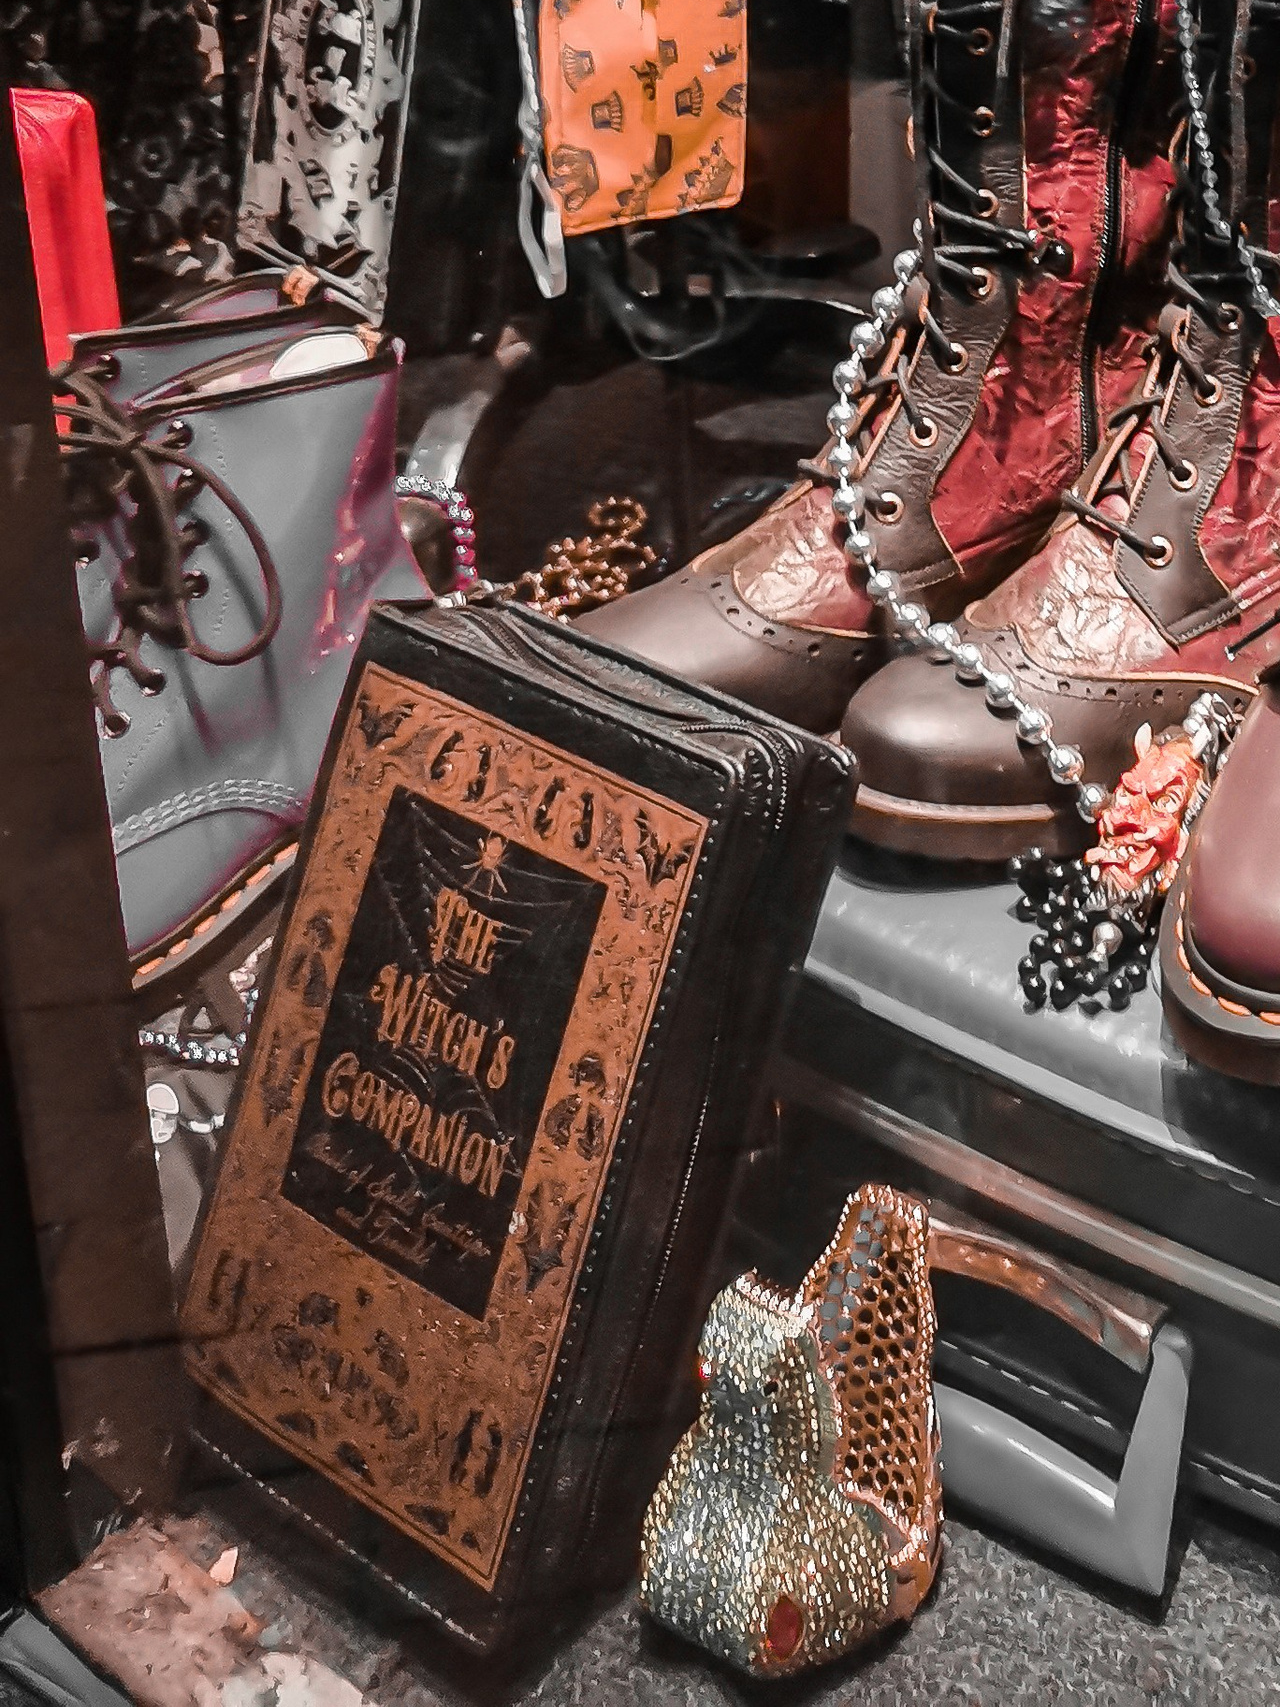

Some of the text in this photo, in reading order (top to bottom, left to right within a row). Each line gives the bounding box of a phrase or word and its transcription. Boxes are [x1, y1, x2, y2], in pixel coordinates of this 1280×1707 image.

[430, 886, 497, 975] THE
[371, 963, 516, 1090] WITCH'S
[321, 1051, 509, 1197] COMPANION
